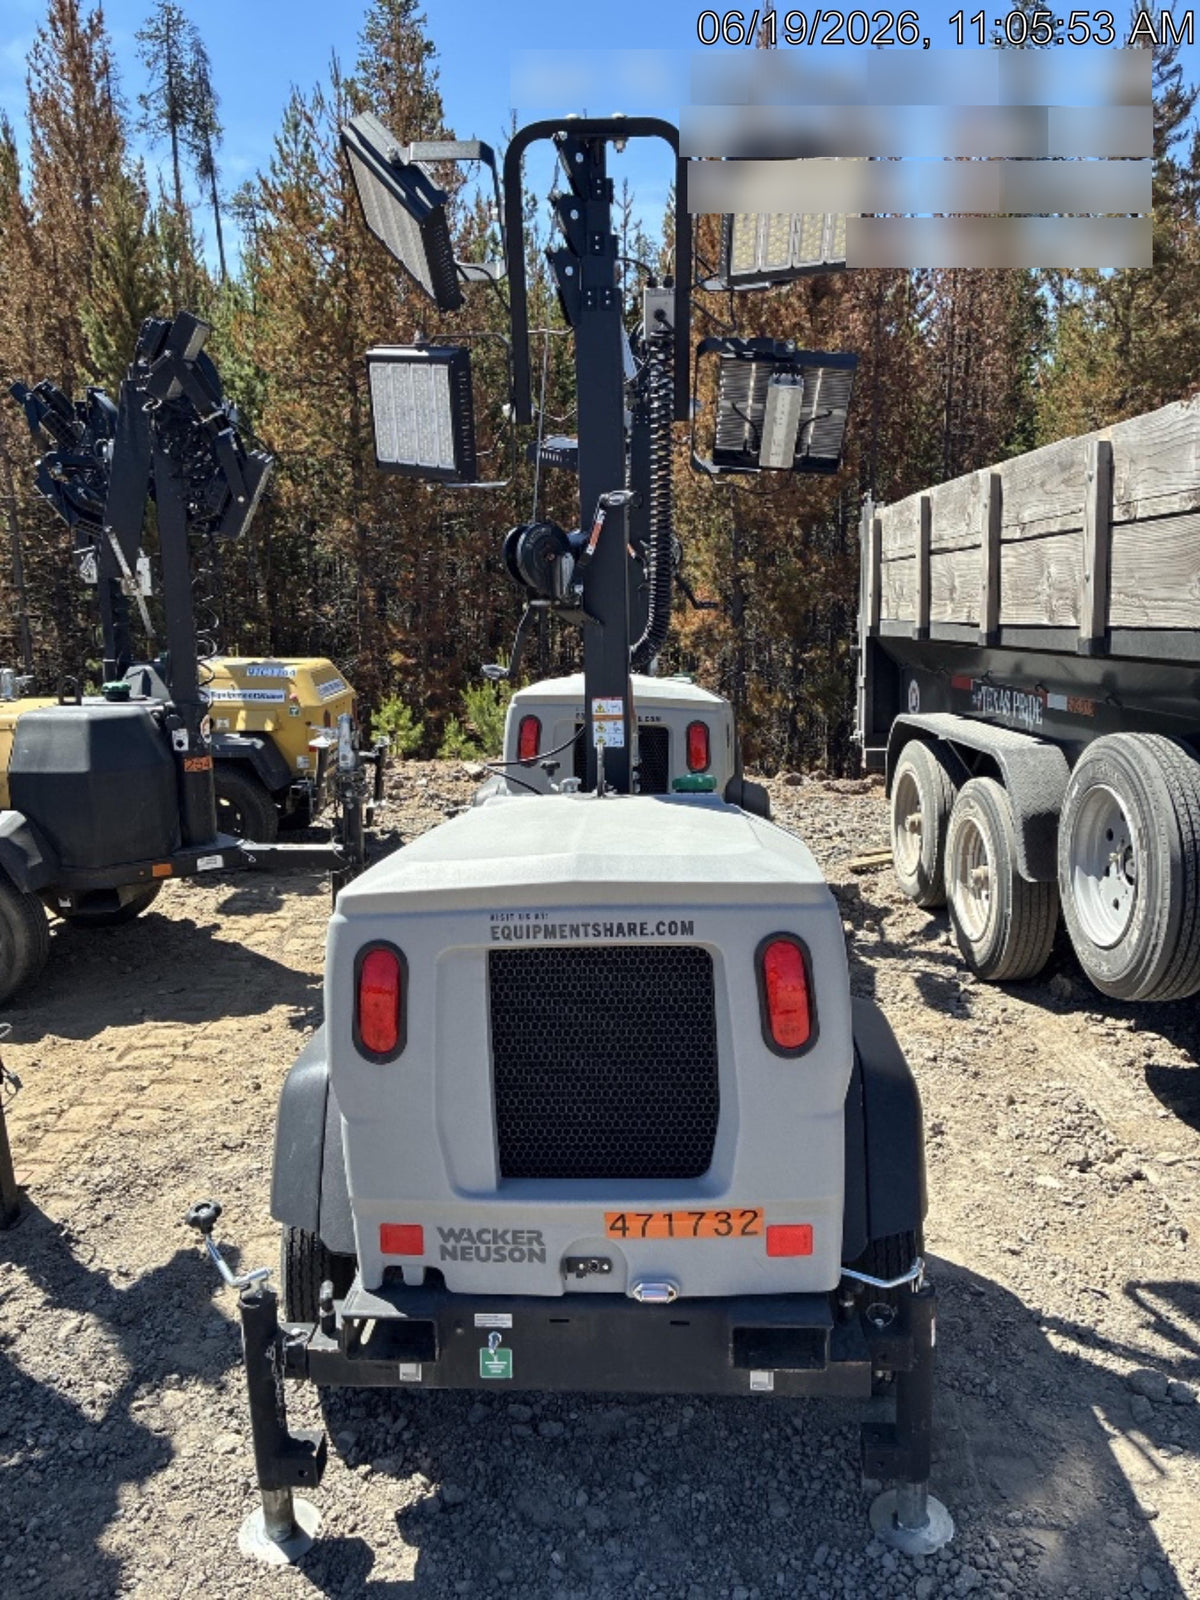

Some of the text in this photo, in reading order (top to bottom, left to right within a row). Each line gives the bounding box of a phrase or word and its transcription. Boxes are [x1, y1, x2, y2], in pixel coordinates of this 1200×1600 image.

[981, 685, 1010, 717] TEXAS
[1012, 690, 1043, 725] PRIDE
[490, 920, 694, 941] EQUIPMENTSHARE.COM
[608, 1209, 760, 1237] 471732
[437, 1226, 546, 1246] WACKER
[439, 1245, 546, 1264] NEUSON
